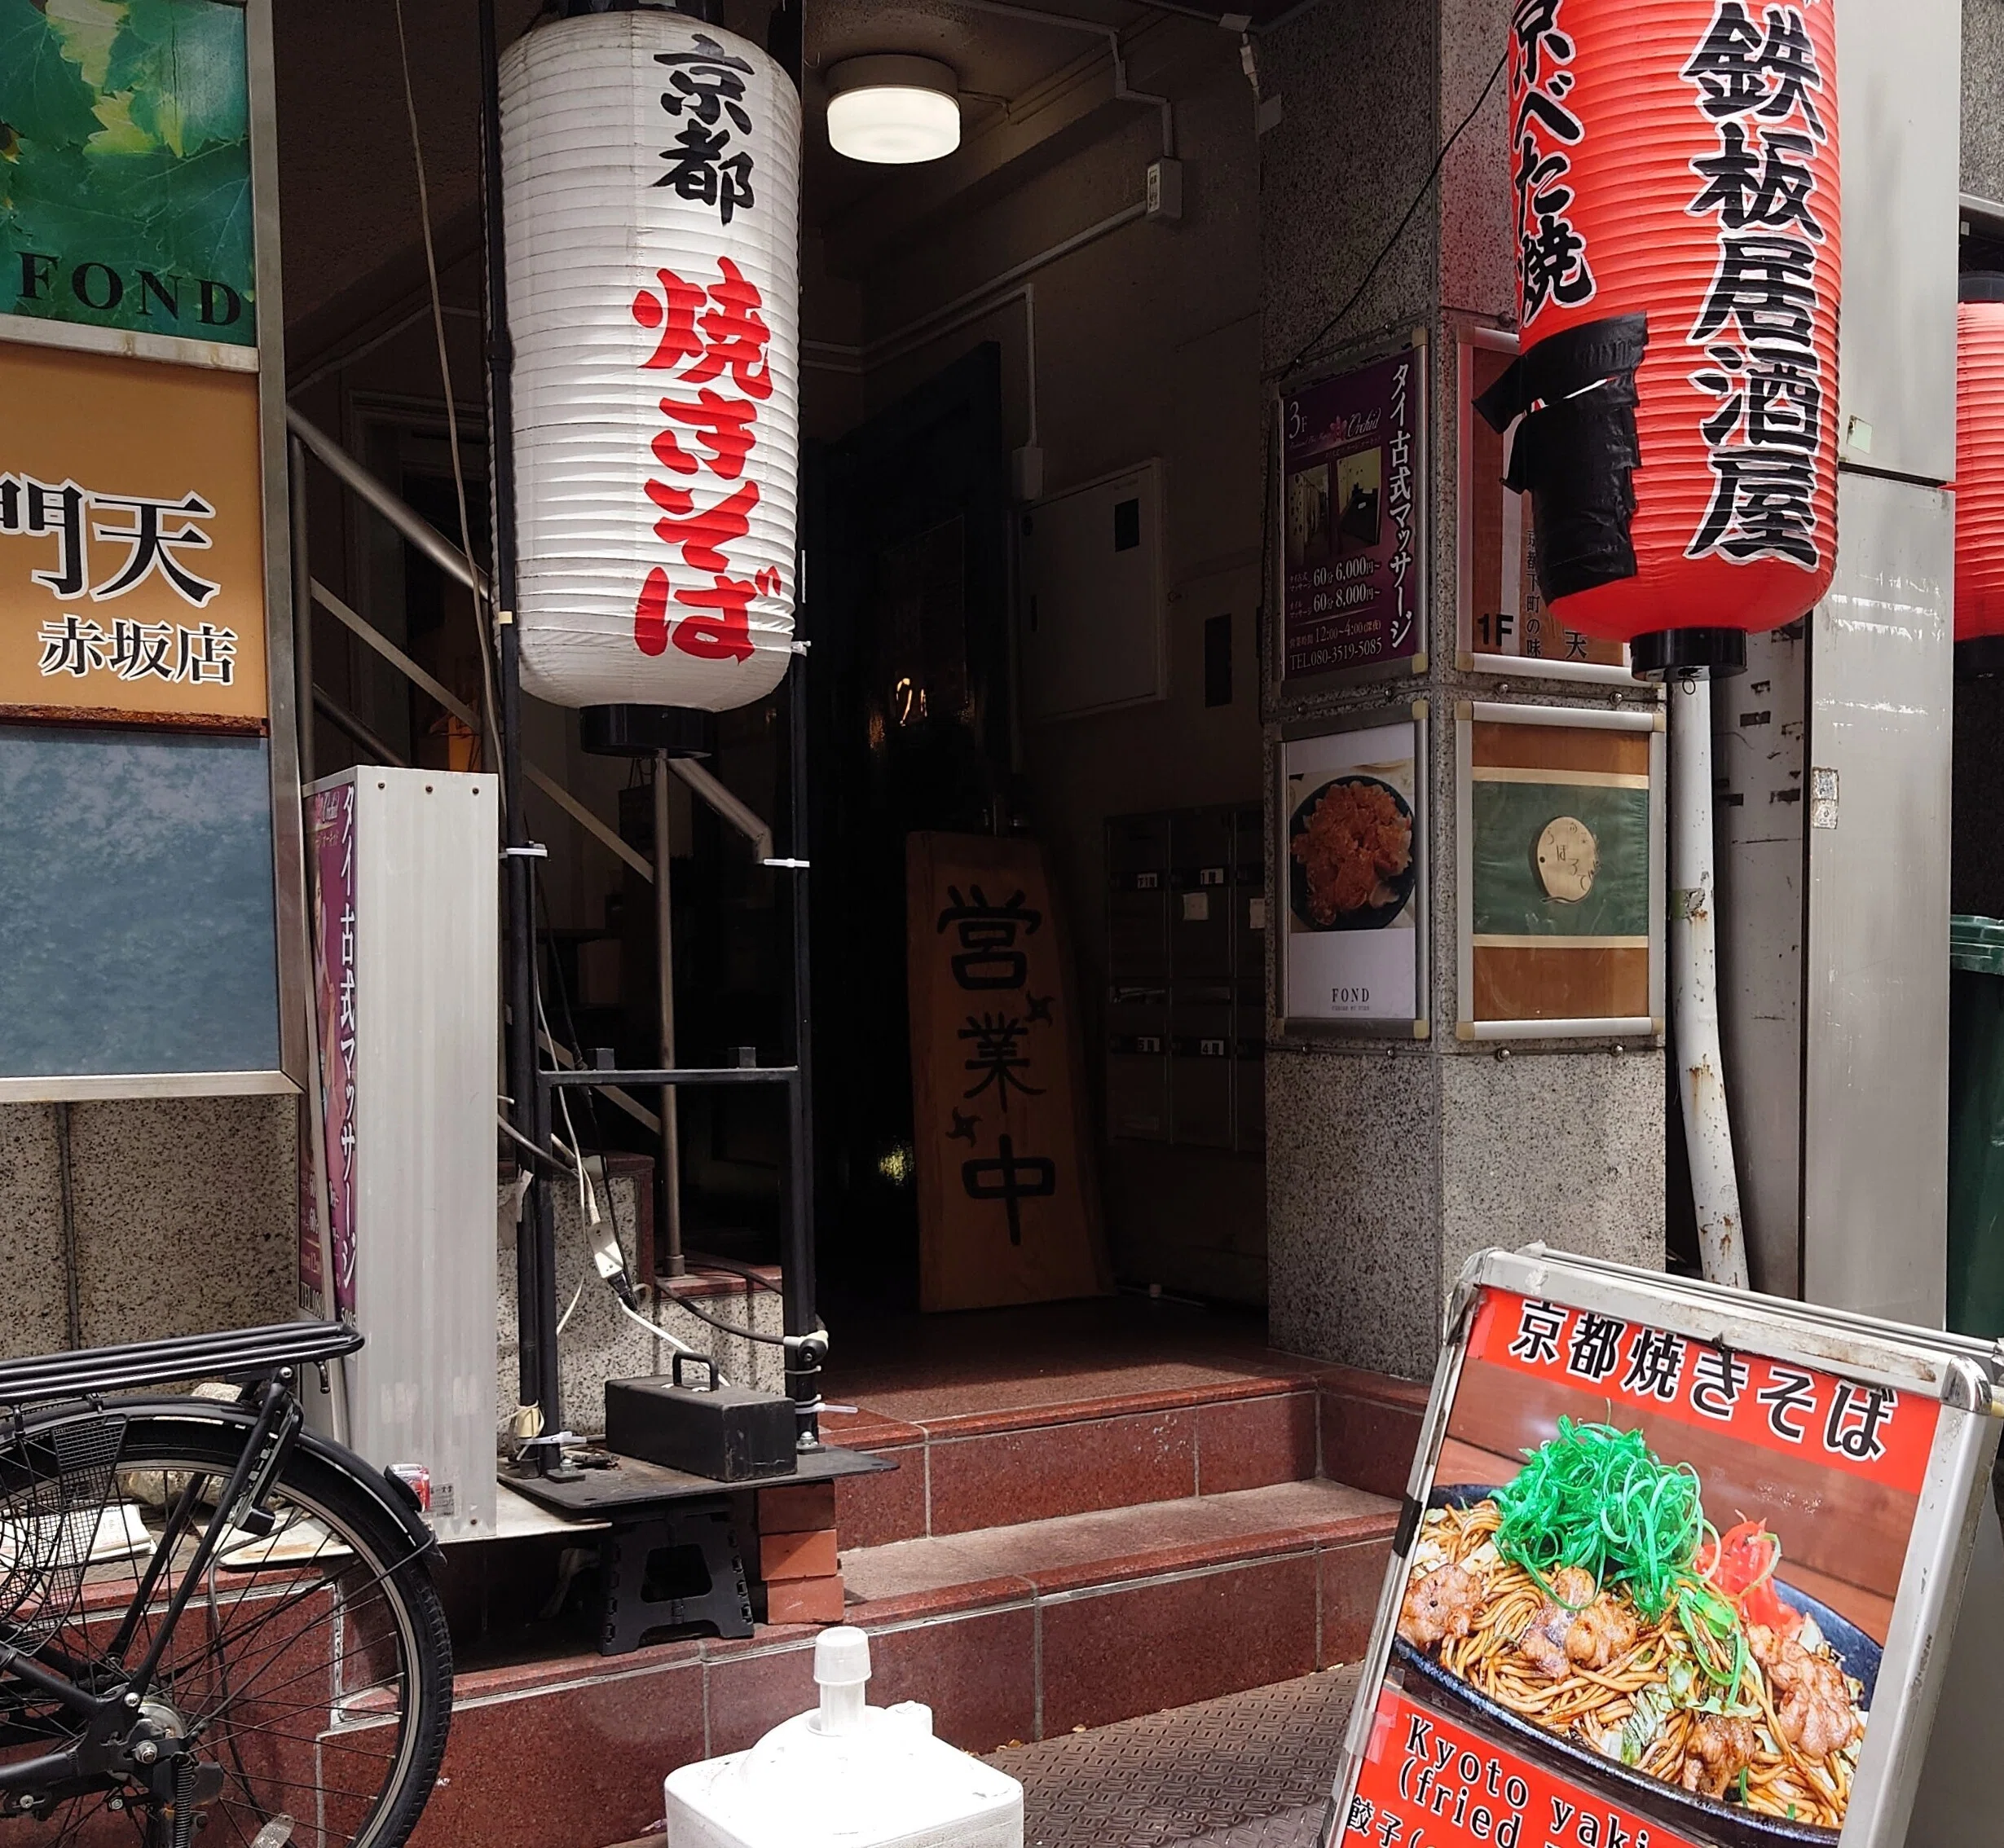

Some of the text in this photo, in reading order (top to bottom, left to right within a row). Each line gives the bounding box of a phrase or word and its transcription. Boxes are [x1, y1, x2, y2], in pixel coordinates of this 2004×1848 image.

[18, 251, 242, 326] FOND
[1680, 0, 1827, 572] 鉄板居酒屋
[632, 33, 782, 665] 京都 焼きそば
[1347, 407, 1381, 438] Orchid
[1389, 363, 1412, 648] タイ古式マッサージ
[37, 614, 238, 685] 赤坂店
[1477, 613, 1513, 647] 1F
[341, 785, 357, 1287] タイ古式マッサージ
[1332, 987, 1370, 1003] FOND
[936, 883, 1056, 1247] 営業中
[1509, 1299, 1900, 1463] 京都焼きそば
[1398, 1758, 1524, 1848] (fried
[1405, 1714, 1530, 1811] Kyoto
